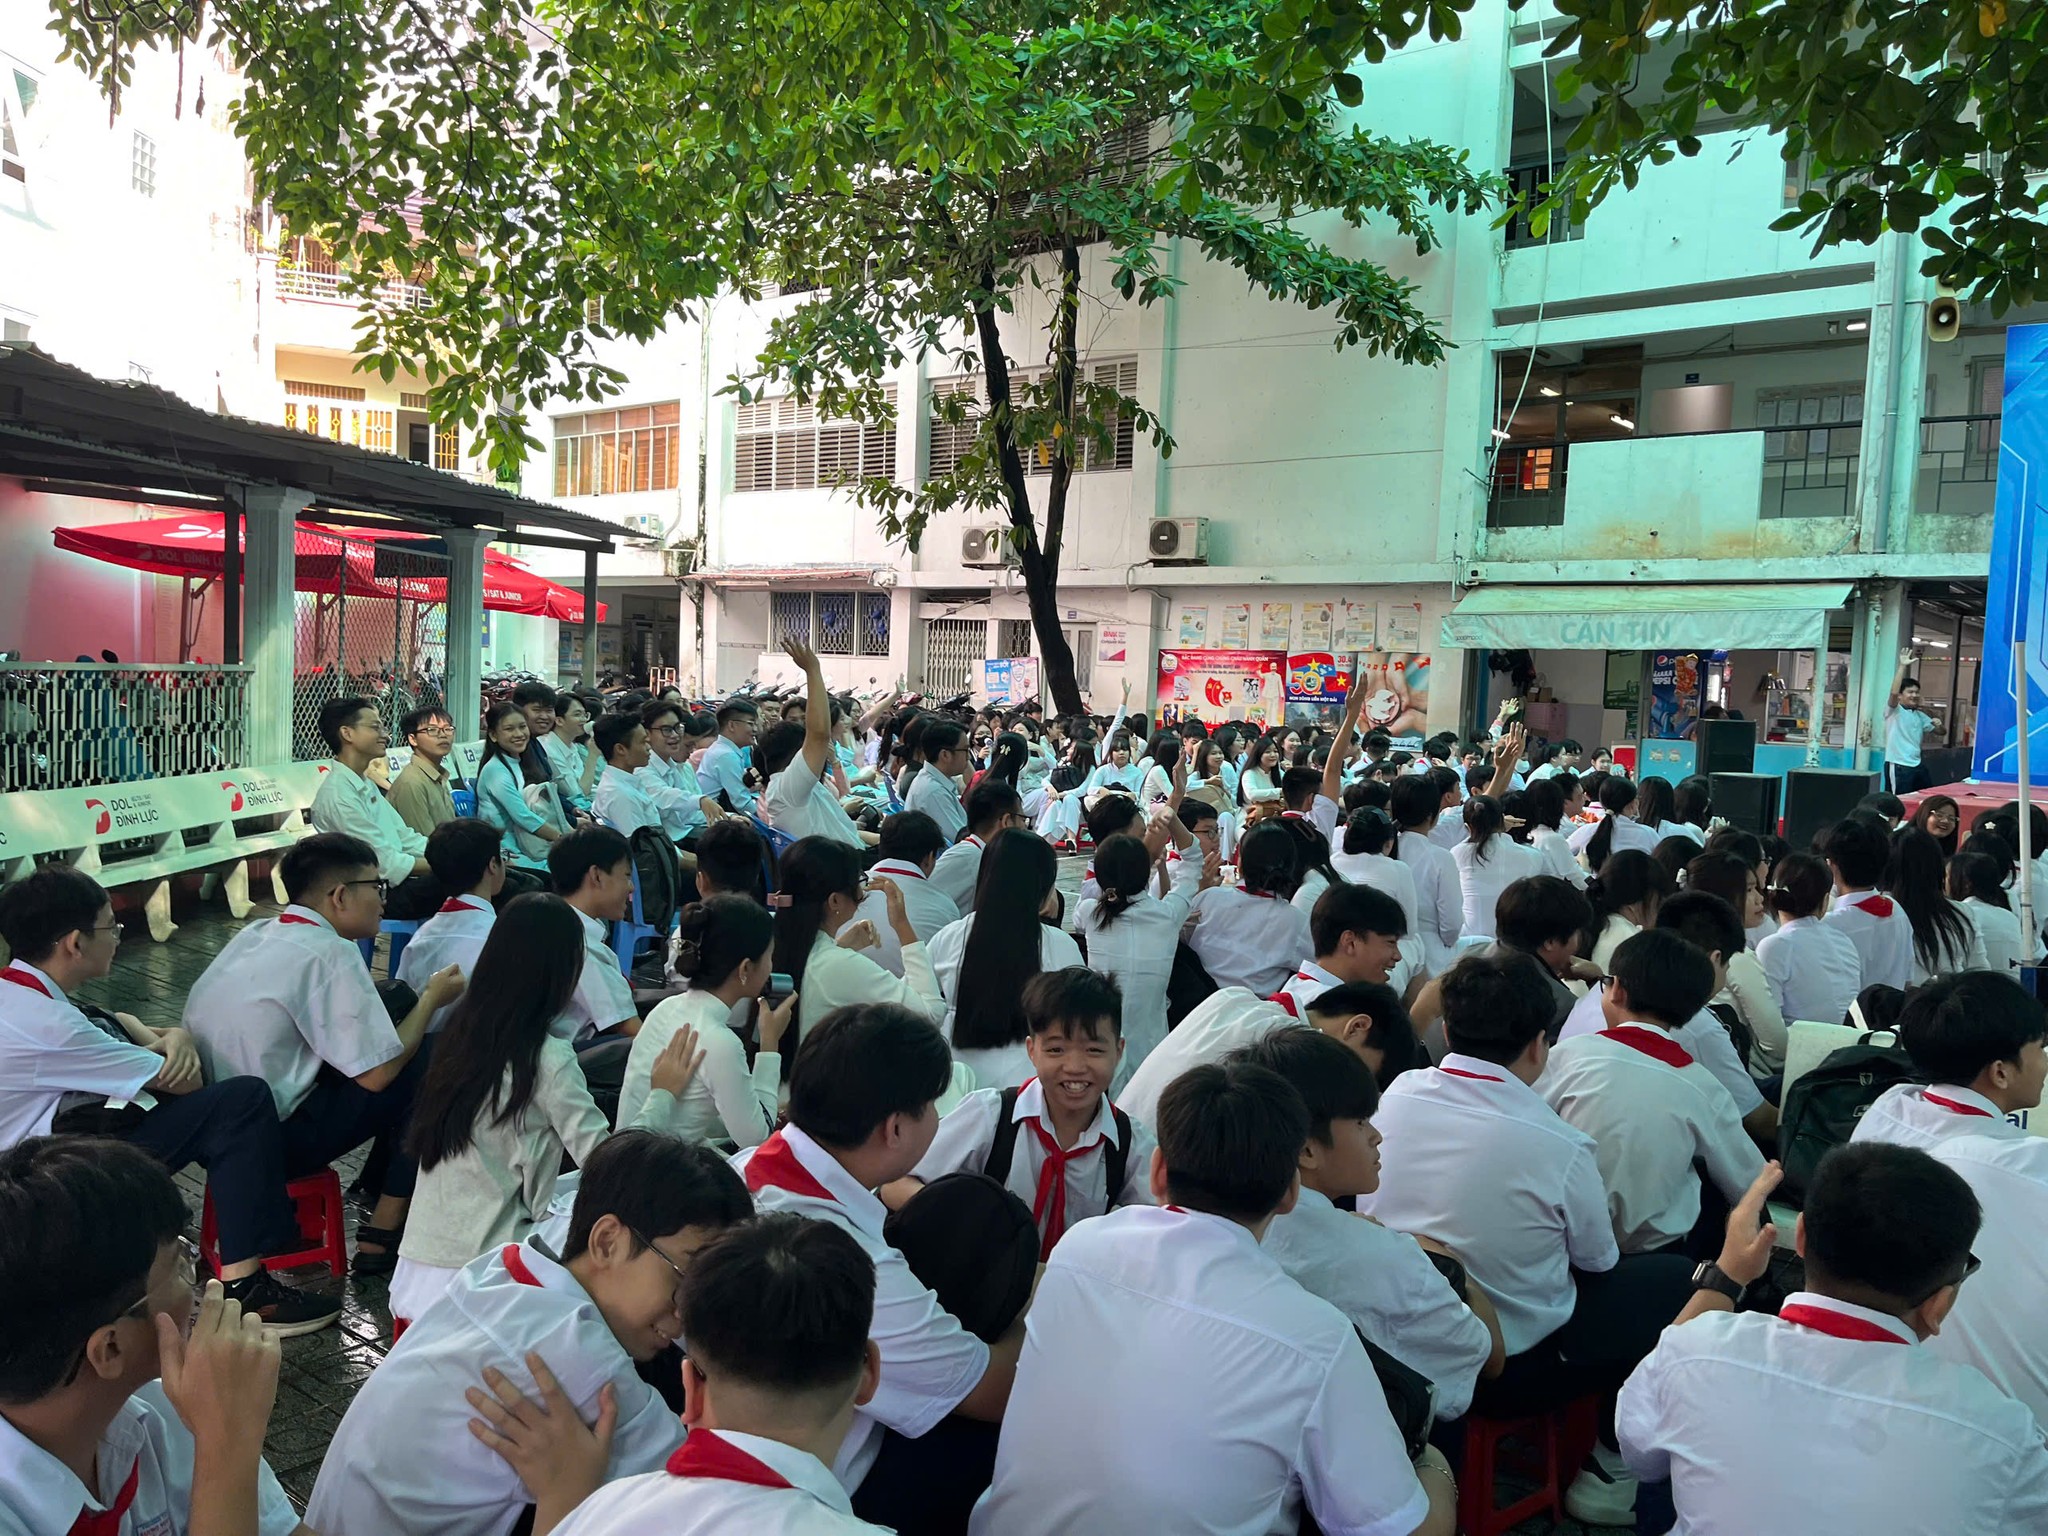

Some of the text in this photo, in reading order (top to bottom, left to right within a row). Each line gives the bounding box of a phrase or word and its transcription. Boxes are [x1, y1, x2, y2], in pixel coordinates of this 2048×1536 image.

[1621, 621, 1671, 643] TIN
[242, 781, 260, 792] DOL
[111, 798, 132, 811] DOL
[248, 793, 268, 806] ĐÌNH
[116, 812, 139, 827] ĐÌNH
